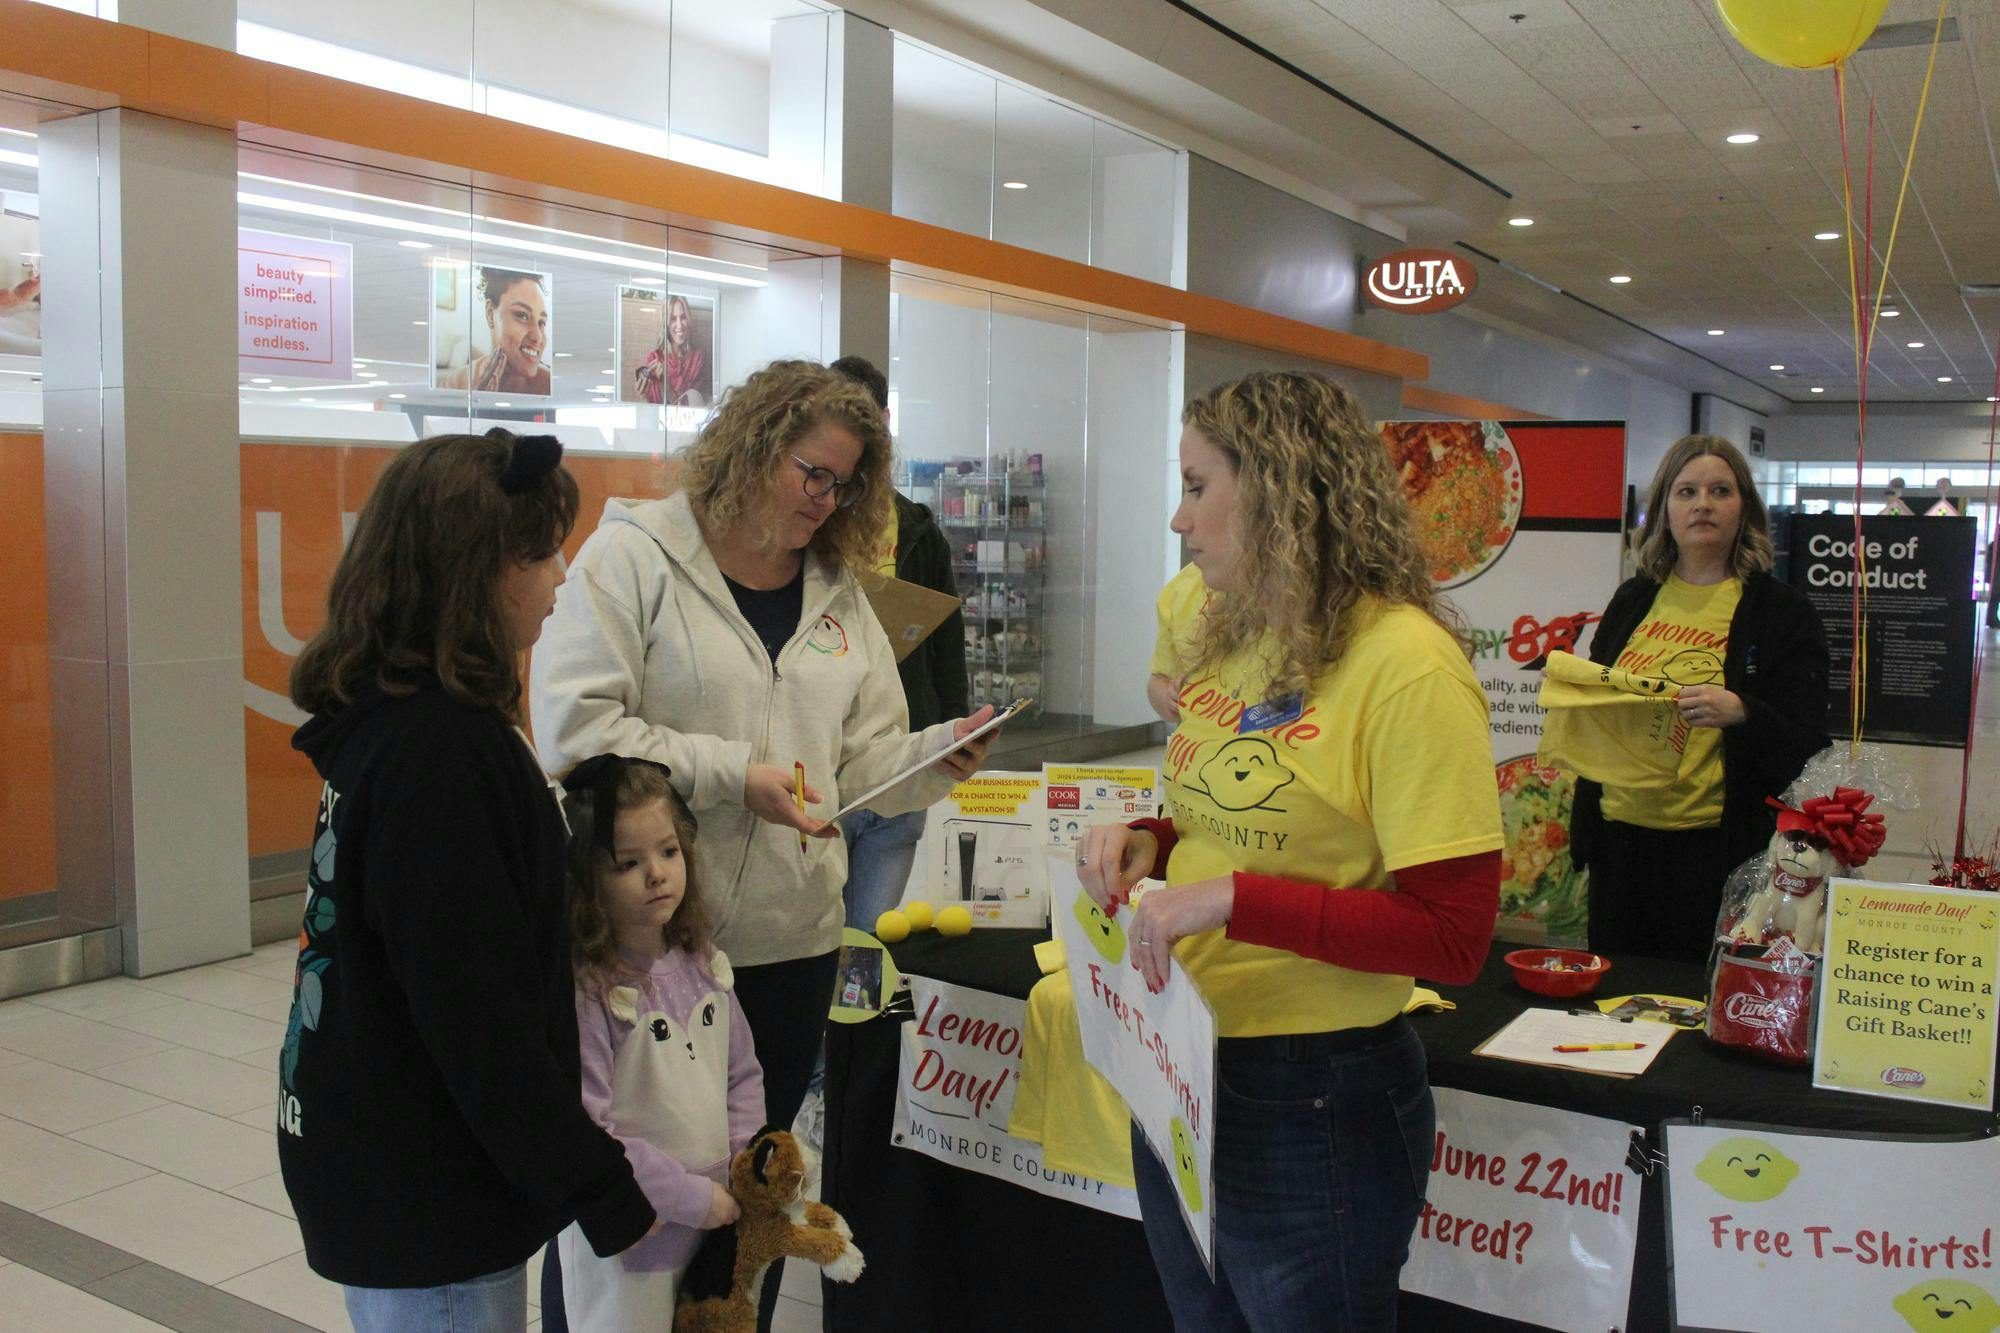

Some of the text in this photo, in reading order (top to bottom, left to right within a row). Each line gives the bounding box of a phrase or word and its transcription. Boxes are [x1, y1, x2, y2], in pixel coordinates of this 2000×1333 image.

[256, 263, 304, 284] beauty
[1382, 260, 1462, 290] ULTA
[244, 283, 317, 304] simplified.
[1405, 286, 1465, 296] BEAUTY
[244, 311, 318, 331] inspiration
[253, 335, 310, 351] endless.
[1808, 534, 1919, 560] Code of
[1807, 563, 1927, 590] Conduct
[1520, 681, 1541, 694] au
[950, 792, 964, 800] FOR
[997, 793, 1007, 801] TO
[983, 779, 1012, 787] BUSINESS
[1013, 779, 1039, 788] RESULTS
[1048, 790, 1077, 800] COOK
[961, 806, 1005, 814] PLAYSTATION
[1200, 814, 1288, 851] COUNTY
[1858, 896, 1973, 924] Lemonade Day!
[1858, 918, 1964, 935] MONROE COUNTY
[1847, 939, 1983, 968] Register for a
[1833, 964, 1993, 995] chance to win a
[1837, 988, 1986, 1020] Raising Cane's
[1846, 1015, 1973, 1045] Gift Basket!!
[1087, 963, 1200, 1140] Free T-Shirts!
[911, 1049, 1010, 1118] Day!
[910, 1119, 1002, 1164] MONROE
[1430, 1130, 1625, 1216] June 22nd!
[1418, 1202, 1534, 1265] tered?
[1708, 1213, 1992, 1270] Free T-Shirts!
